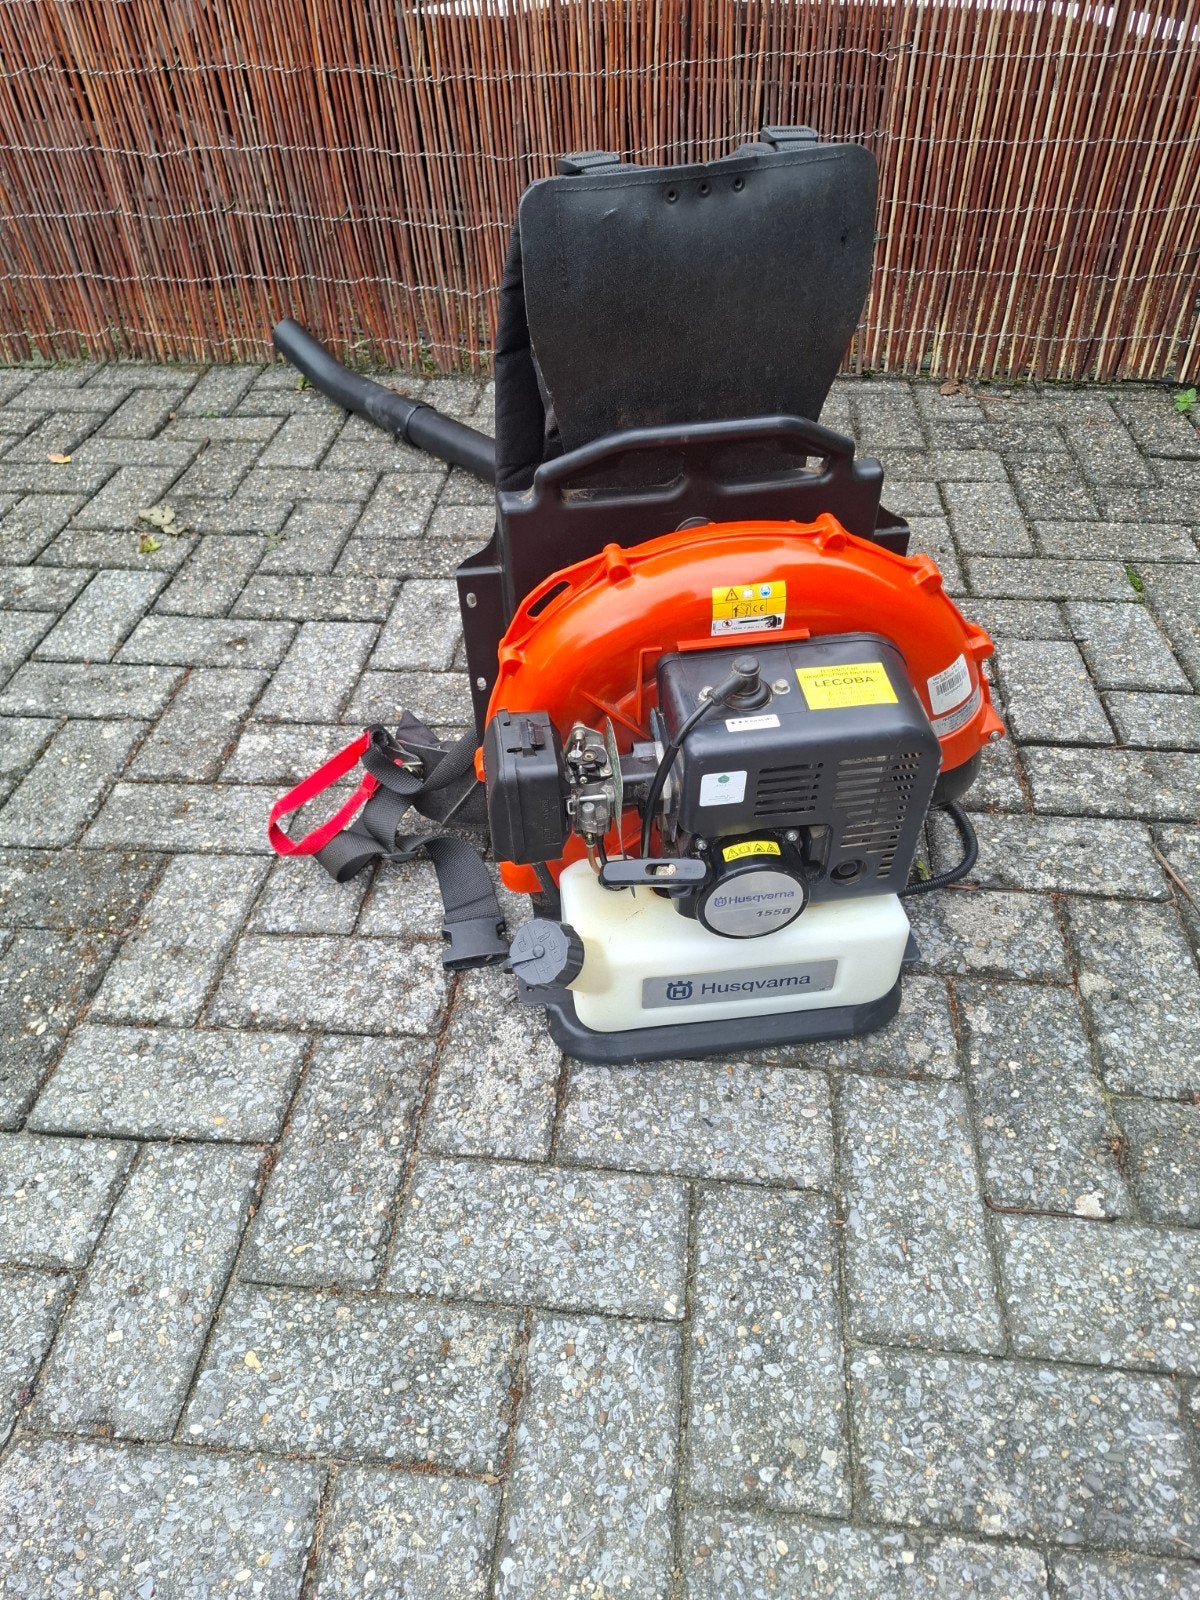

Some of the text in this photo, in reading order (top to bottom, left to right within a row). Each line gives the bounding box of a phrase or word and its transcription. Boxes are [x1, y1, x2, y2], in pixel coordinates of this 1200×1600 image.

[814, 676, 875, 688] LECOBA
[728, 890, 795, 905] Husqvarna
[755, 907, 792, 917] 155B
[701, 974, 811, 995] Husqvarna
